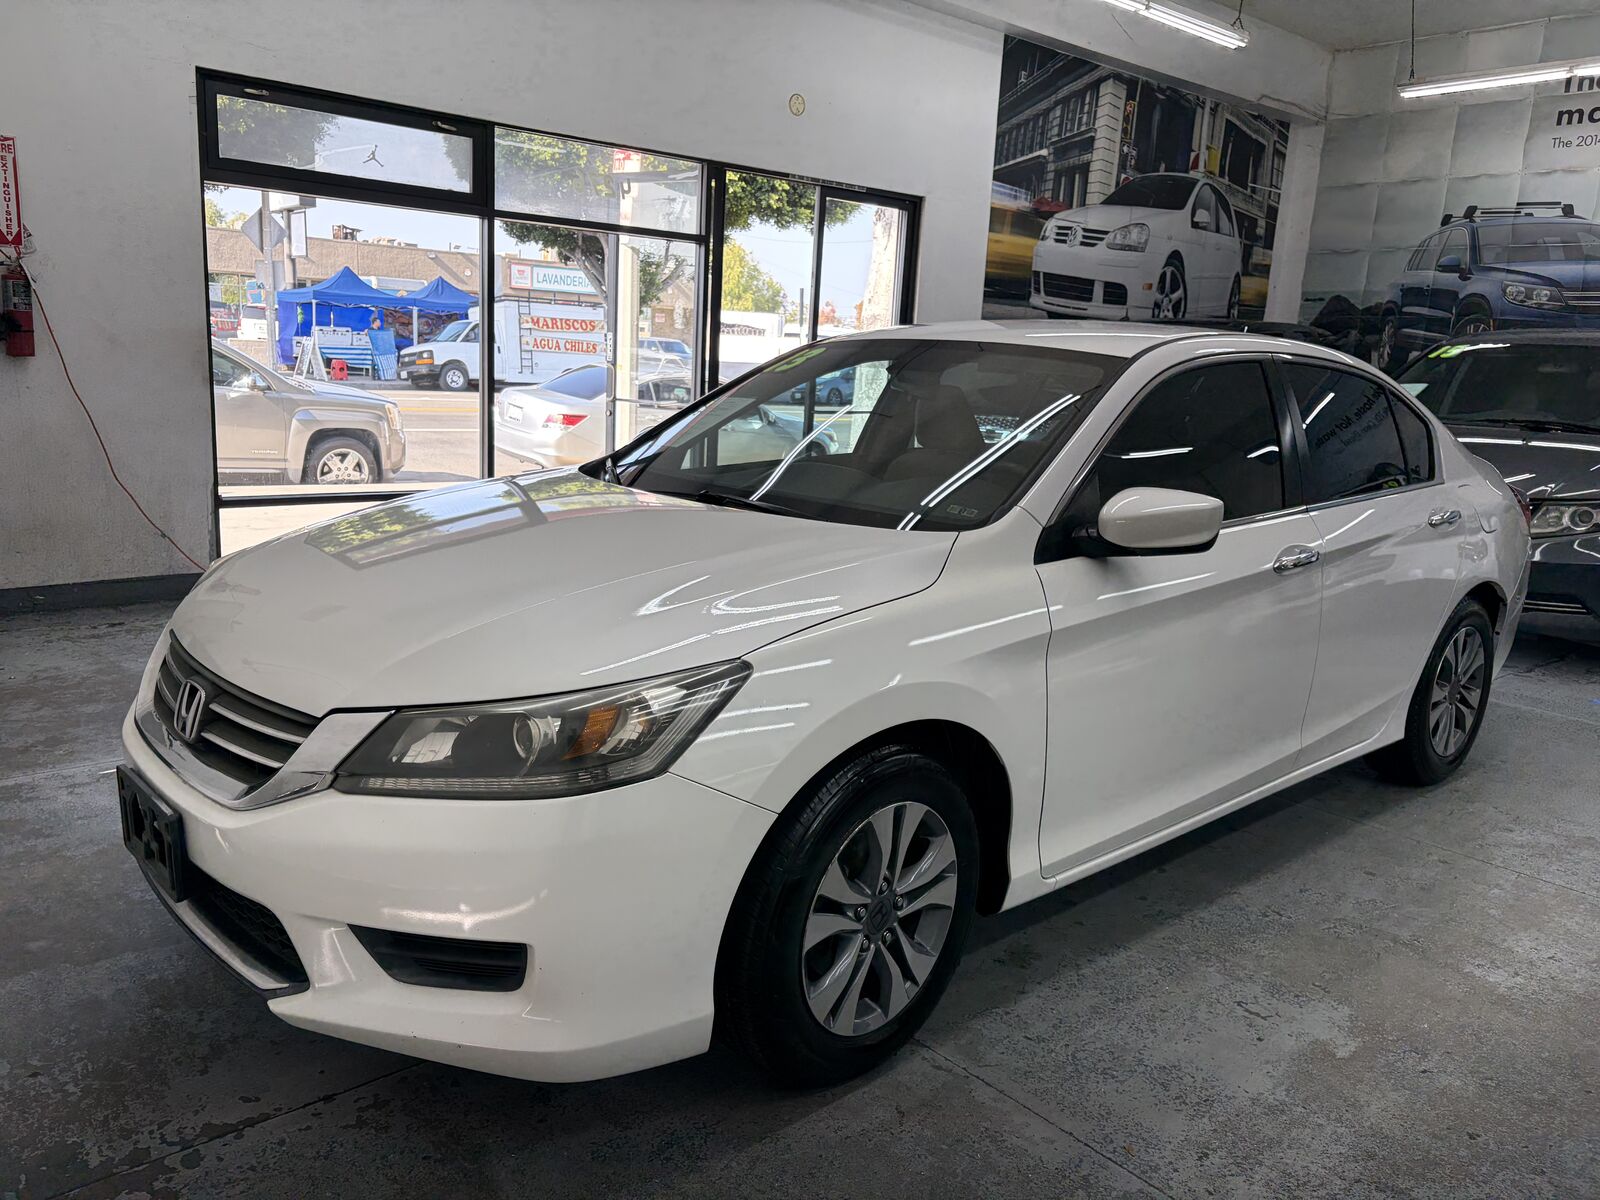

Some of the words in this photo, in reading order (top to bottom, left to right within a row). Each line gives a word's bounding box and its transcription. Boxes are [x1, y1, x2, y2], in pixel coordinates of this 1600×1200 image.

[1551, 136, 1572, 149] The
[1575, 134, 1600, 147] 201
[0, 154, 13, 237] EXTINGUISHER
[530, 316, 597, 332] MARISCOS
[532, 338, 561, 350] AGUA
[564, 340, 598, 353] CHILES
